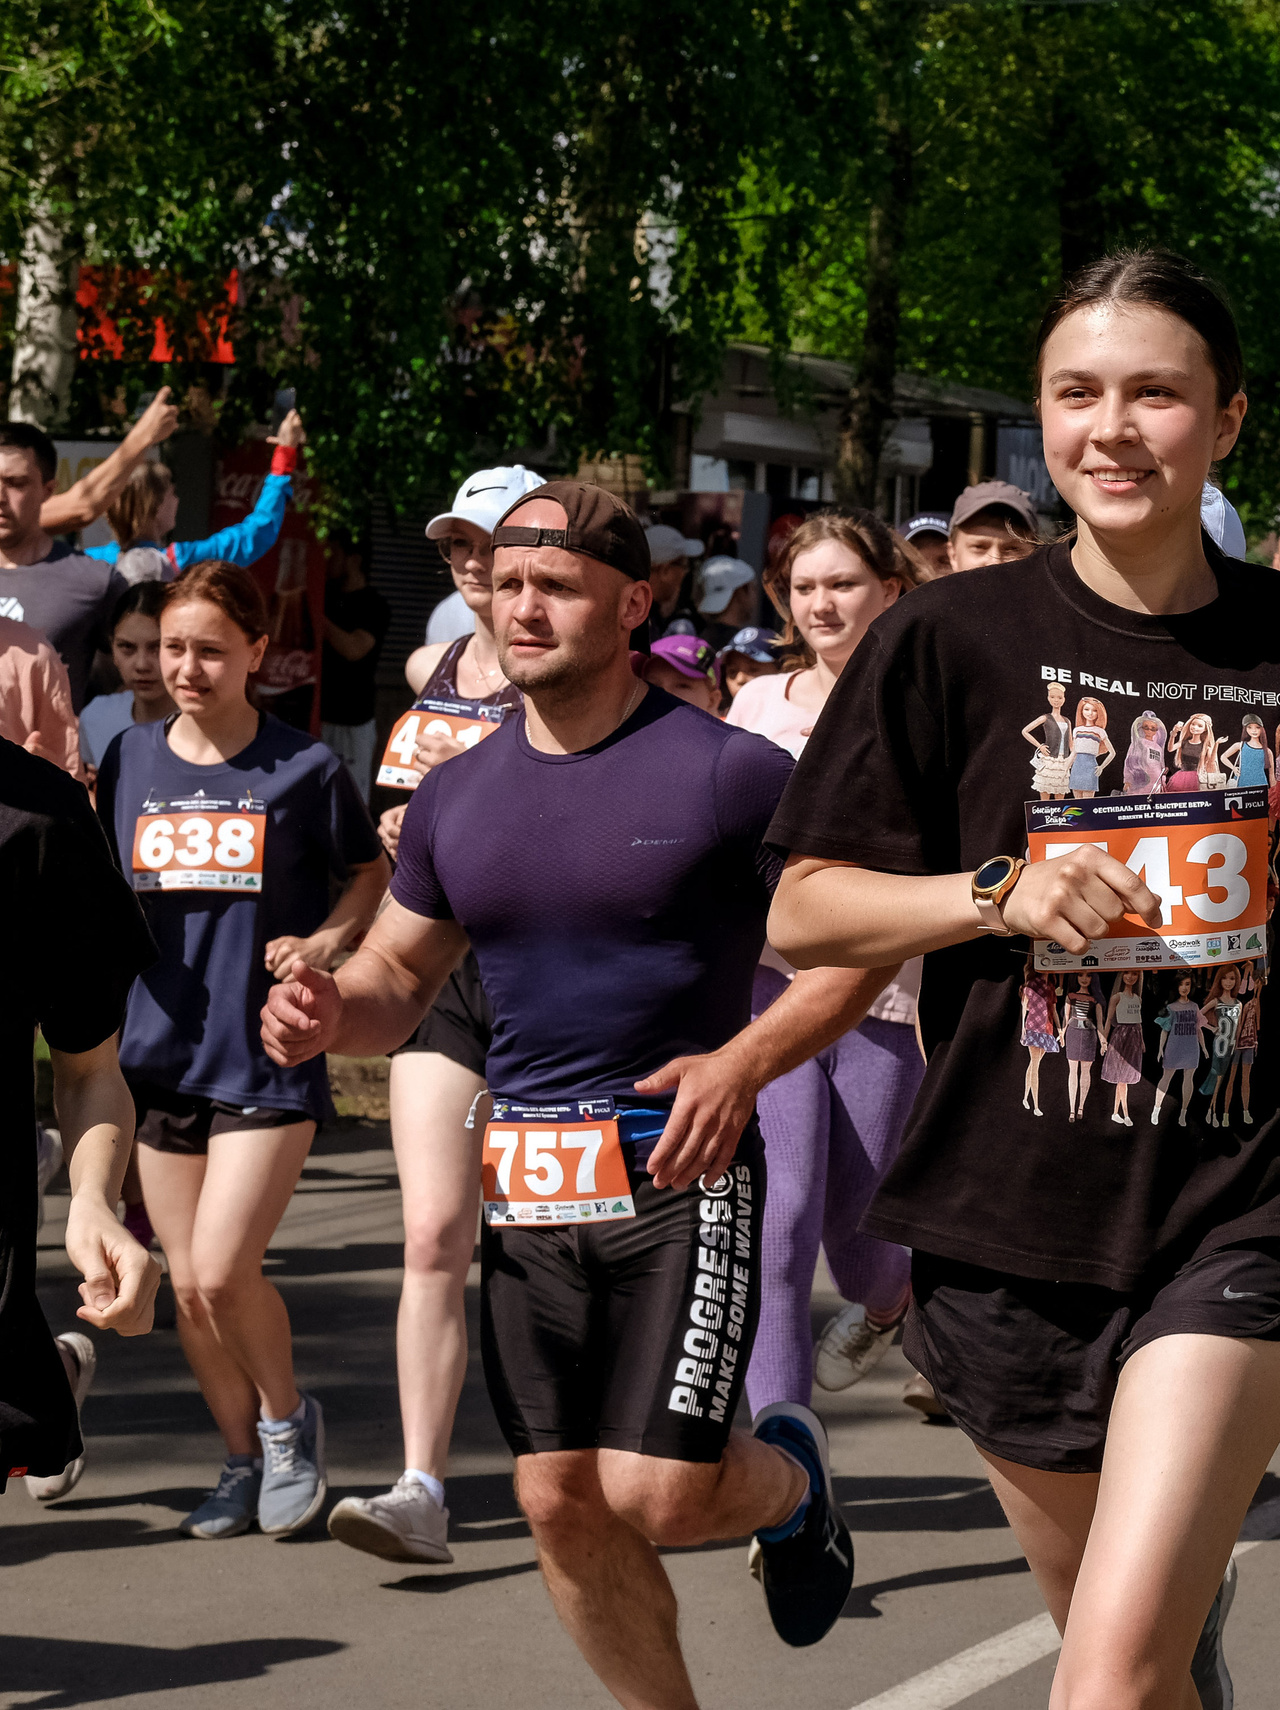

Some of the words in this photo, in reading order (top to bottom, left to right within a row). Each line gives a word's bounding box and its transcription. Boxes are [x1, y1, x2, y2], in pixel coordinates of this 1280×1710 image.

[1041, 665, 1073, 683] BE
[1079, 671, 1140, 697] REAL
[1147, 681, 1198, 700] NOT
[1031, 805, 1062, 817] Быстрее
[1092, 805, 1134, 814] ФЕСТИВАЛЬ
[1134, 803, 1152, 811] БЕГА
[1244, 800, 1265, 809] РУСАЛ
[139, 817, 255, 868] 638
[488, 1129, 603, 1196] 757
[734, 1164, 753, 1259] WAVES
[667, 1198, 732, 1417] PROGRESS
[726, 1263, 750, 1343] SOME
[708, 1343, 738, 1424] MAKE
